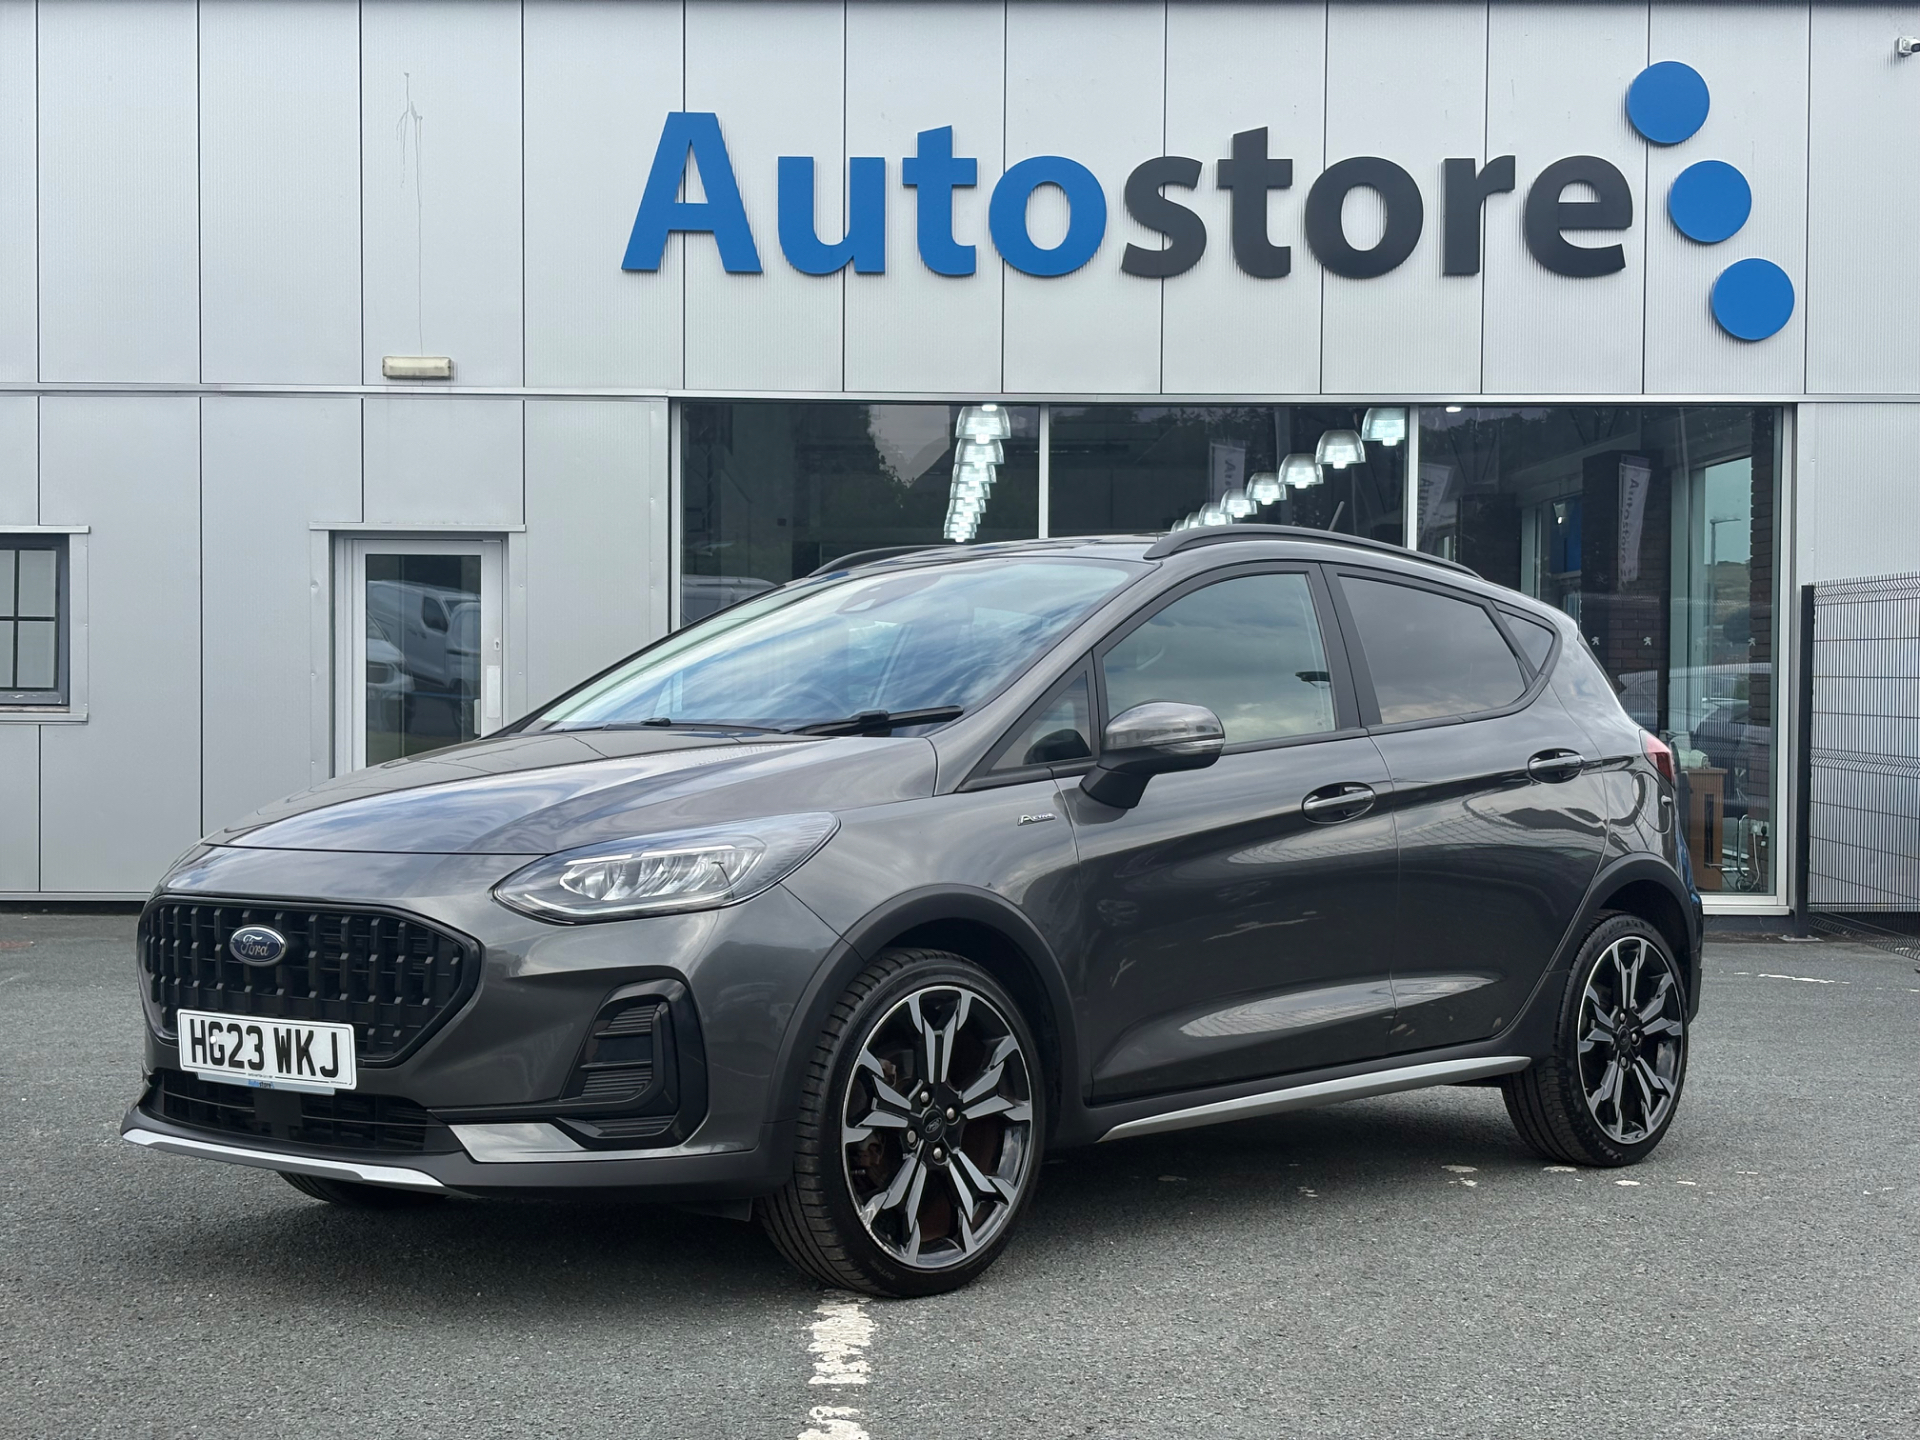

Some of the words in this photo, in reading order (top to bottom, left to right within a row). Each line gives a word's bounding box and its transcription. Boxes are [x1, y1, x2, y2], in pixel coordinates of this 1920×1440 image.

[621, 112, 1634, 278] Autostore
[240, 934, 270, 956] Ford
[189, 1018, 265, 1071] HG23
[273, 1027, 339, 1078] WKJ
